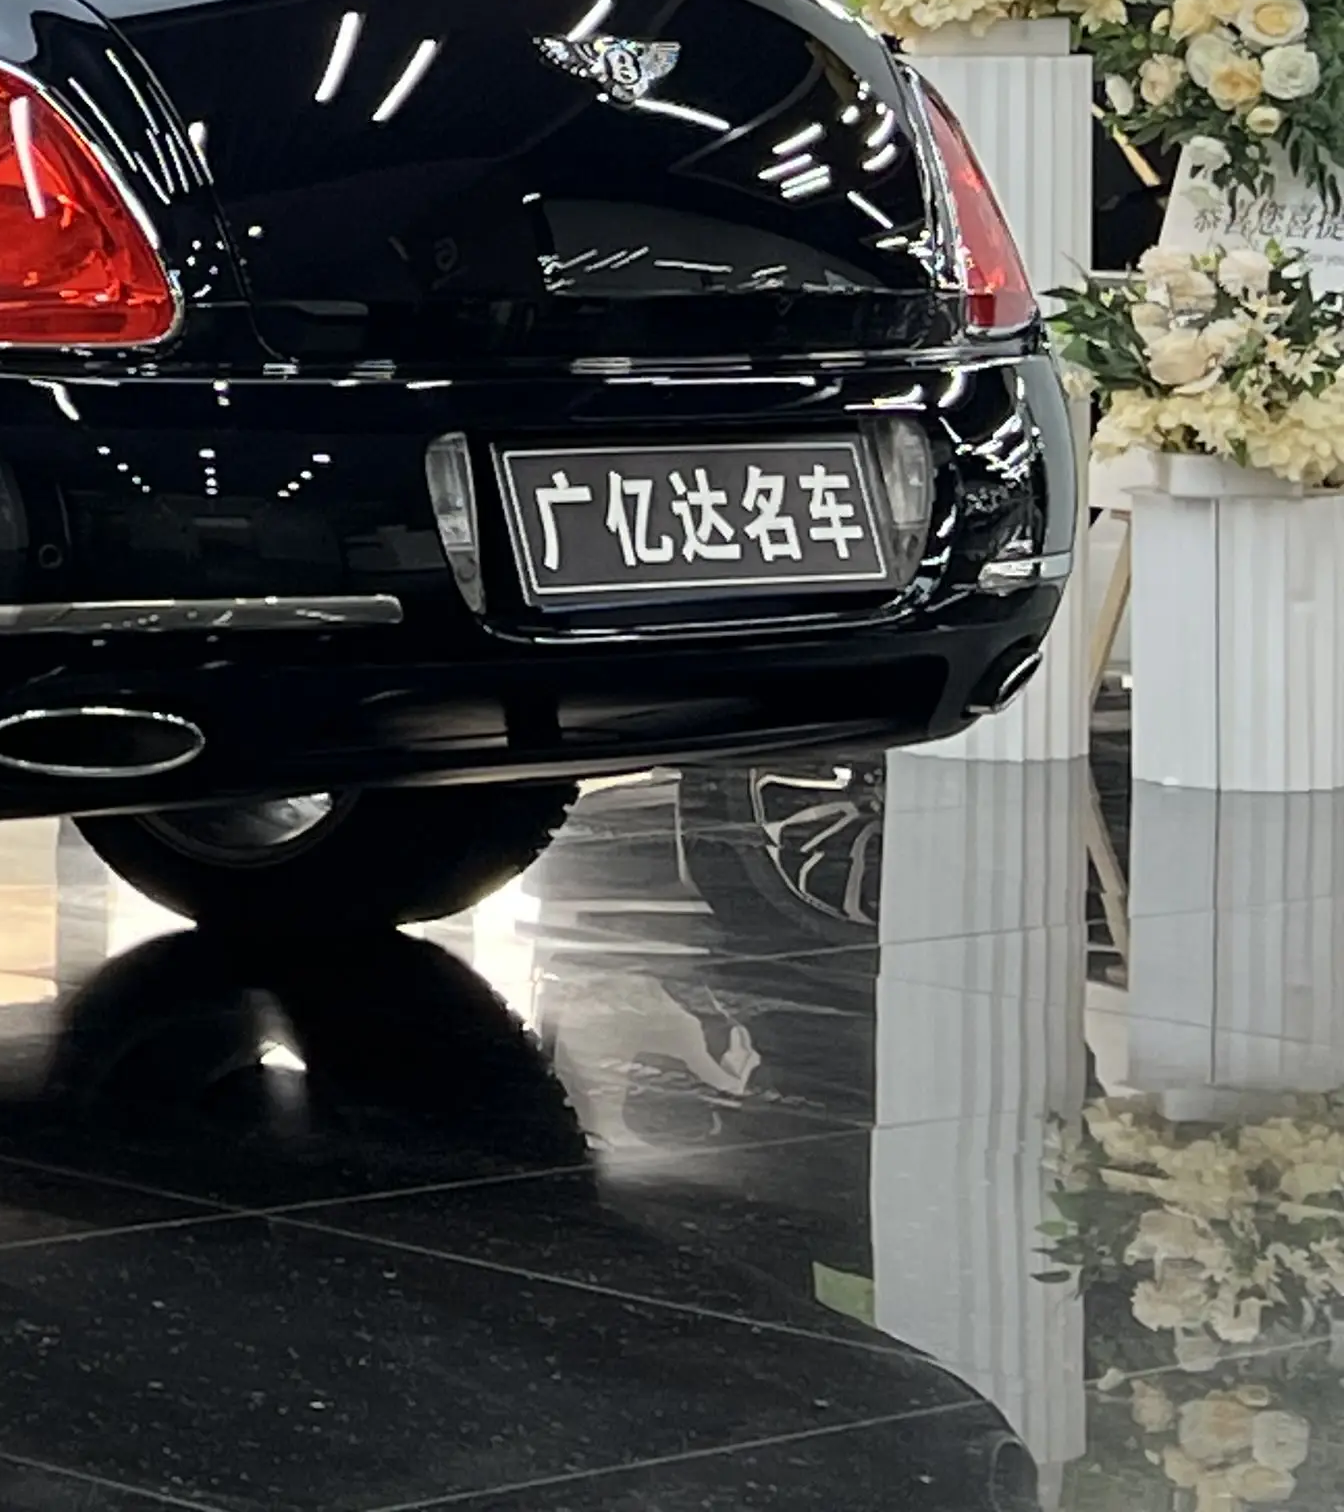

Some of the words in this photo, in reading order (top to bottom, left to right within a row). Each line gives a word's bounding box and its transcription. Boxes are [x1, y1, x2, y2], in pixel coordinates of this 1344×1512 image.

[534, 464, 864, 571] 广亿达名车
